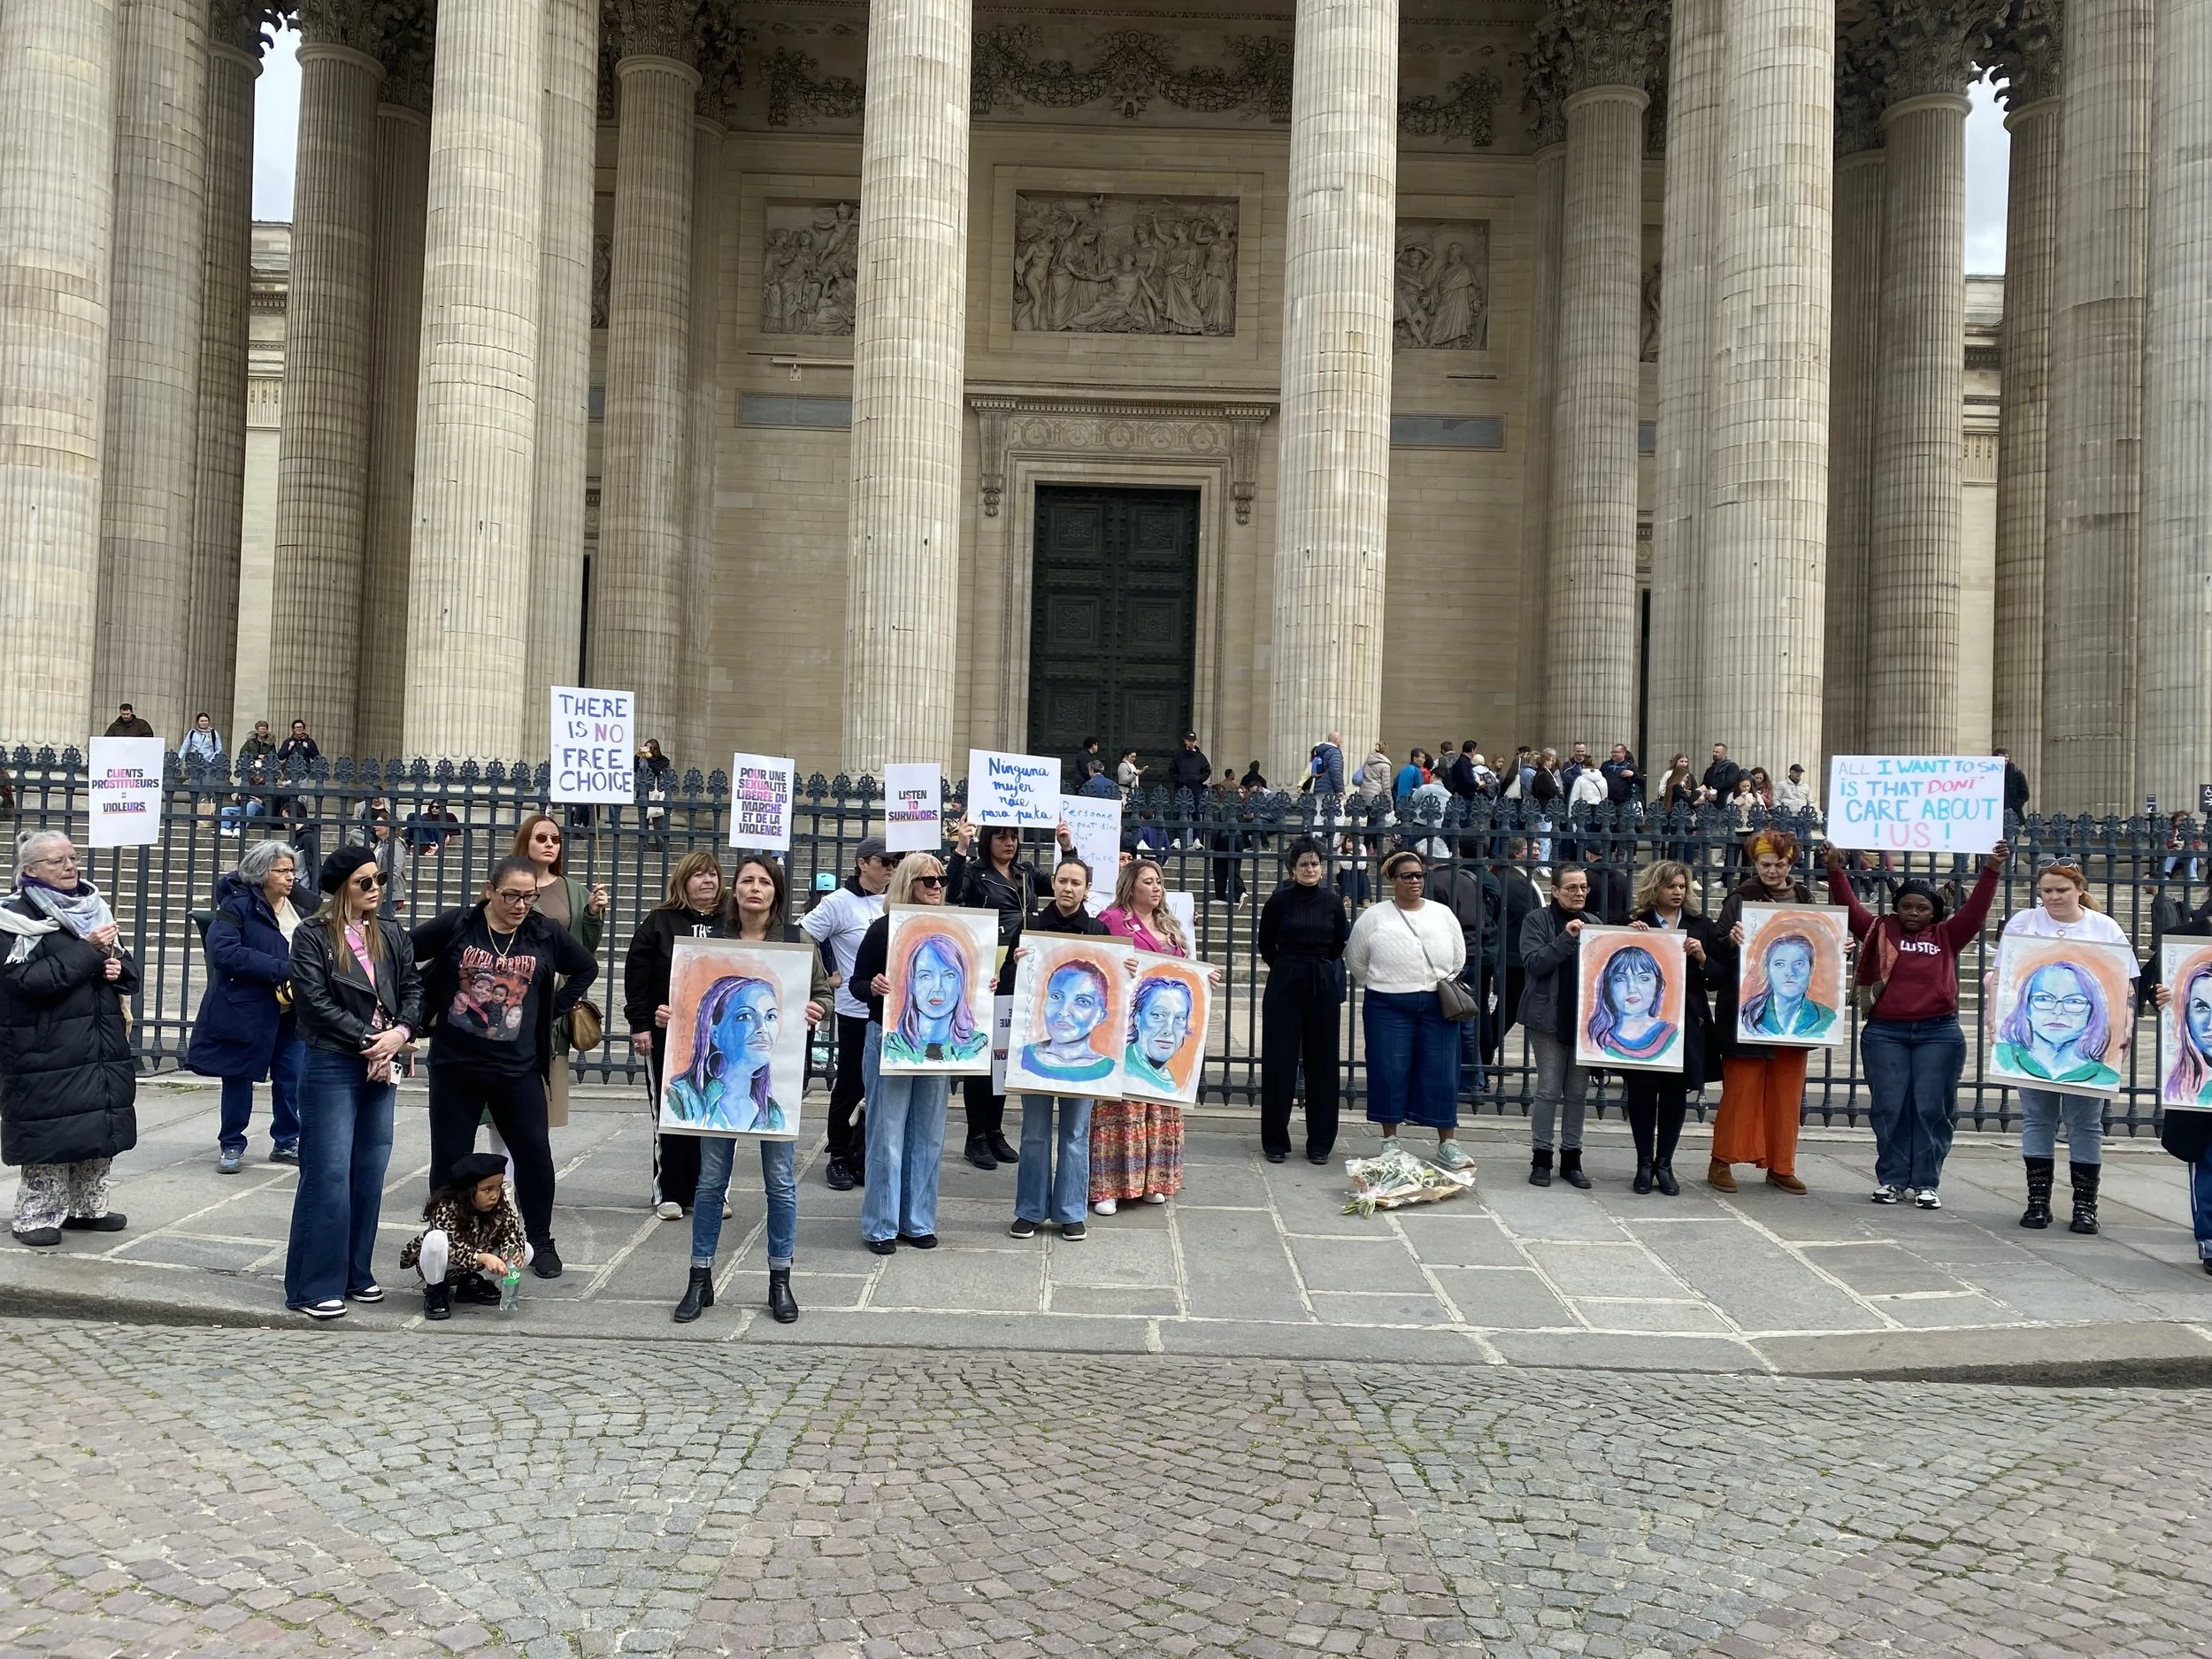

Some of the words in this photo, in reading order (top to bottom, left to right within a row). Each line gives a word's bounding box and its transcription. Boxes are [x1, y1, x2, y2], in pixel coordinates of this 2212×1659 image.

[558, 694, 627, 718] THERE
[568, 720, 588, 739] IS
[595, 722, 624, 743] NO
[106, 768, 143, 778] CLIENTS
[741, 767, 767, 780] POUR
[769, 770, 787, 782] UNE
[988, 757, 1049, 783] Ninguna
[1839, 762, 1870, 776] ALL
[1877, 759, 1893, 775] I
[1896, 759, 1951, 773] WANT
[1954, 760, 1975, 773] TO
[91, 779, 159, 789] PROSTITUEURS
[992, 780, 1034, 797] mujer
[1866, 780, 1924, 797] THAT
[775, 793, 787, 803] DU
[899, 790, 927, 800] LISTEN
[999, 796, 1029, 807] nace
[103, 802, 146, 812] VIOLEURS
[907, 801, 918, 810] TO
[1063, 801, 1113, 820] Personne
[1846, 799, 1911, 823] CARE
[1921, 798, 1999, 820] ABOUT
[742, 812, 753, 823] ET
[756, 813, 767, 824] DE
[770, 814, 780, 825] LA
[888, 810, 938, 821] SURVIVORS
[978, 810, 1010, 822] para
[1014, 804, 1053, 824] puta
[739, 823, 782, 836] VIOLENCE
[1889, 821, 1932, 849] US
[1080, 853, 1115, 864] orture
[1023, 944, 1035, 1044] SURVIVANTE
